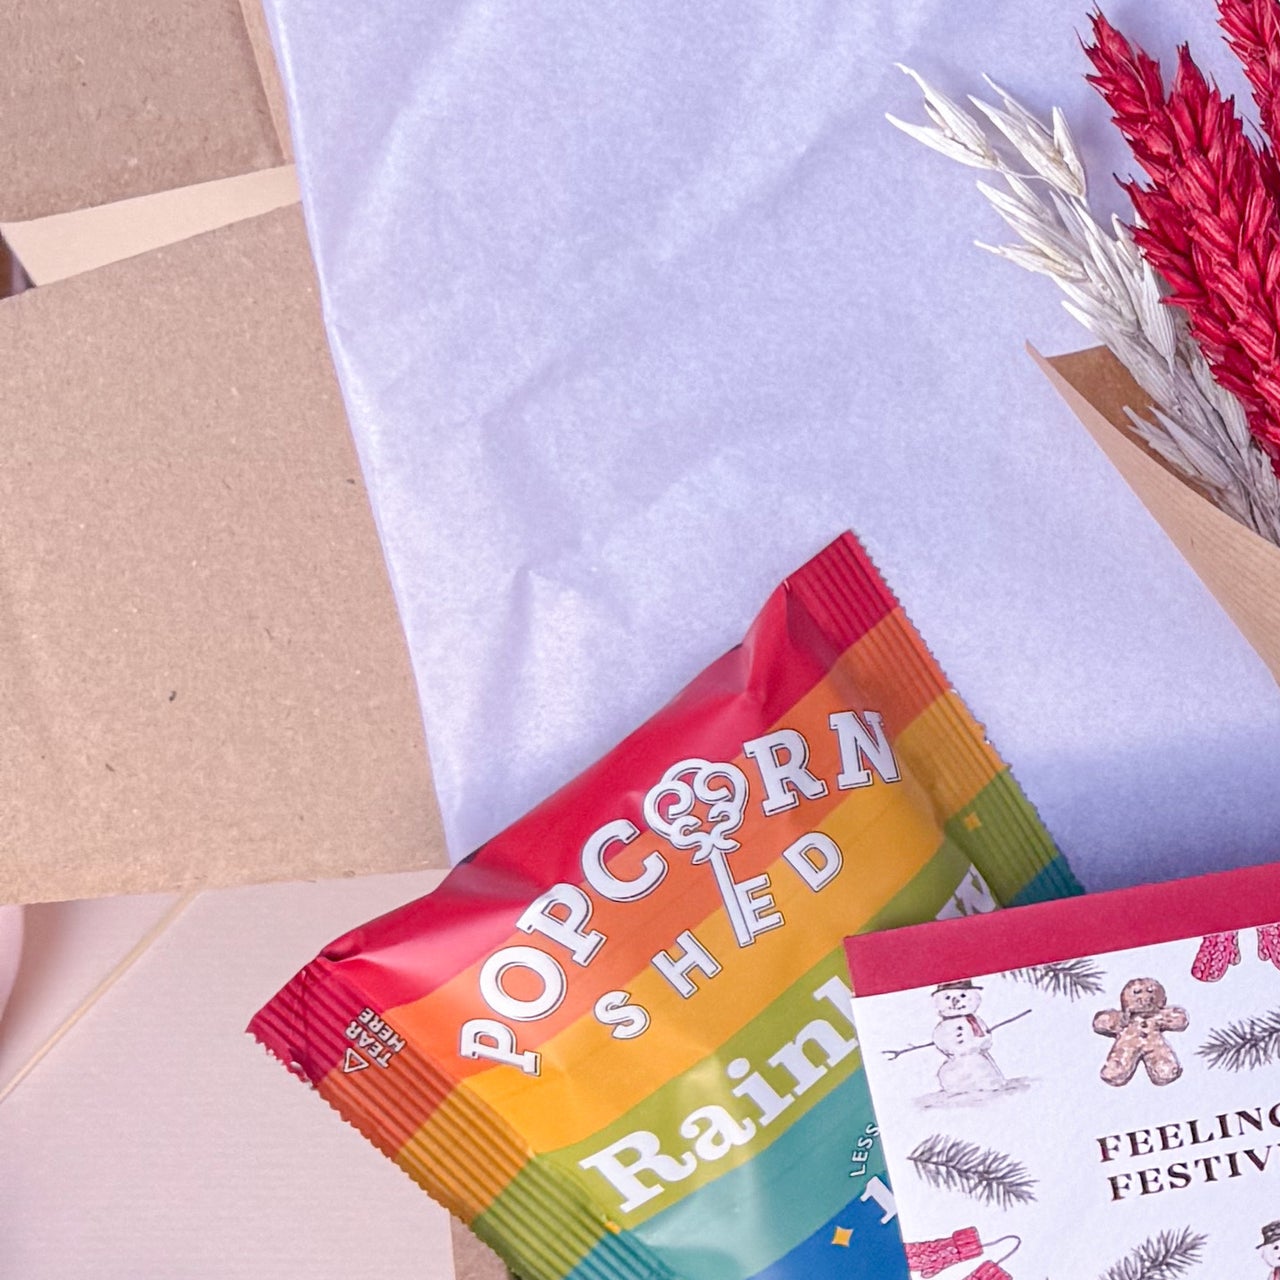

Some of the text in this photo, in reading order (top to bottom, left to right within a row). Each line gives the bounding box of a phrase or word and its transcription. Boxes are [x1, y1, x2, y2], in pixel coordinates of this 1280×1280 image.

[593, 831, 844, 1040] SHED
[345, 1021, 393, 1068] TEAR
[358, 1007, 407, 1053] HERE
[849, 1123, 880, 1177] LESS
